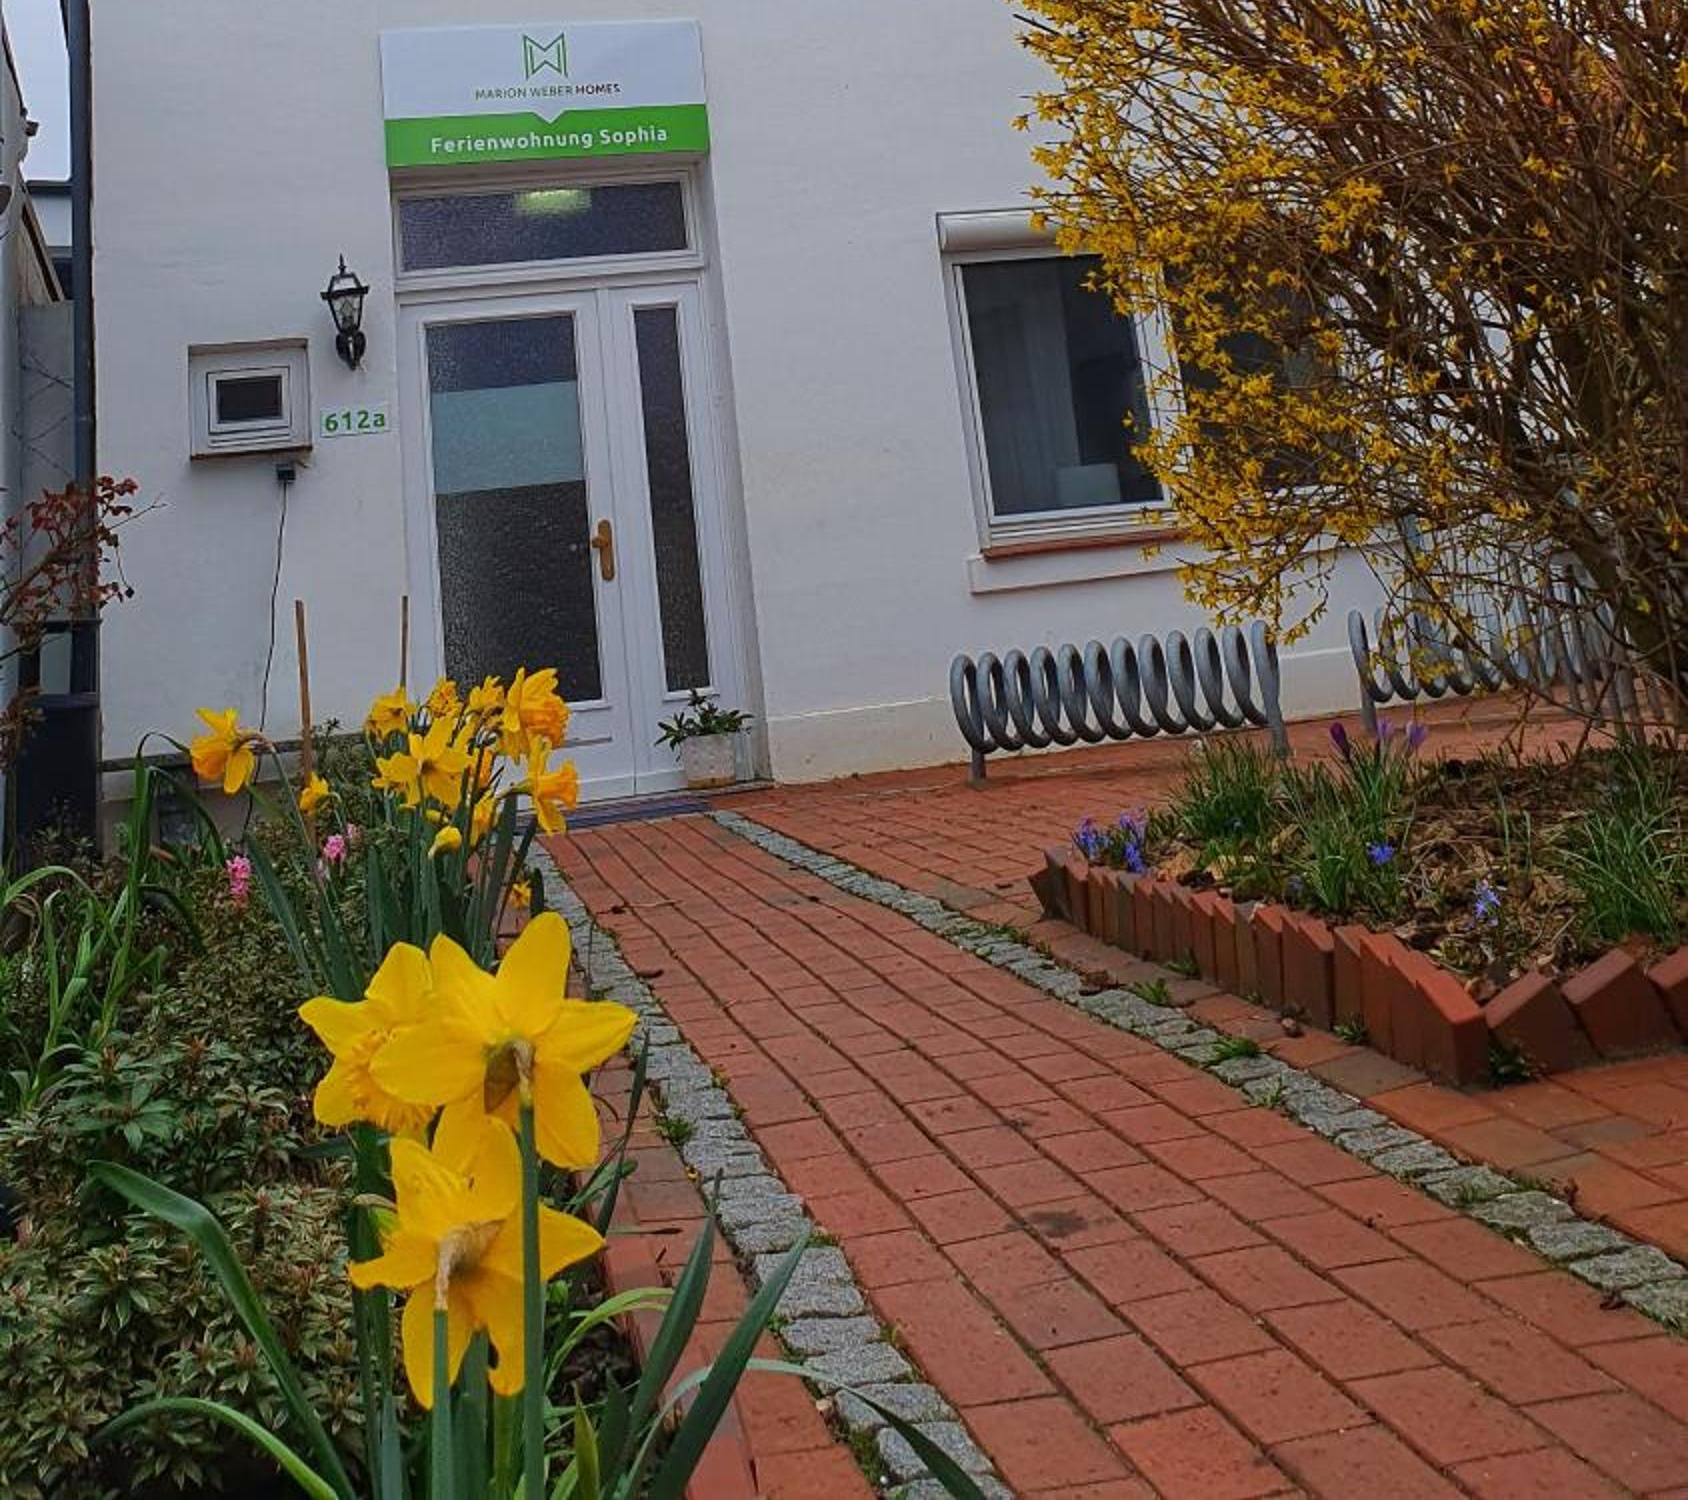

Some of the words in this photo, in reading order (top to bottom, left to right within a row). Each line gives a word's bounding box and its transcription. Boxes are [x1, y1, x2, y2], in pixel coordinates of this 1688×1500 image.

[475, 87, 527, 100] MARION
[529, 85, 573, 97] WEBER
[575, 83, 621, 95] HOMES
[431, 131, 593, 153] Ferienwohnung
[600, 125, 668, 146] Sophia
[324, 409, 385, 431] 612a
